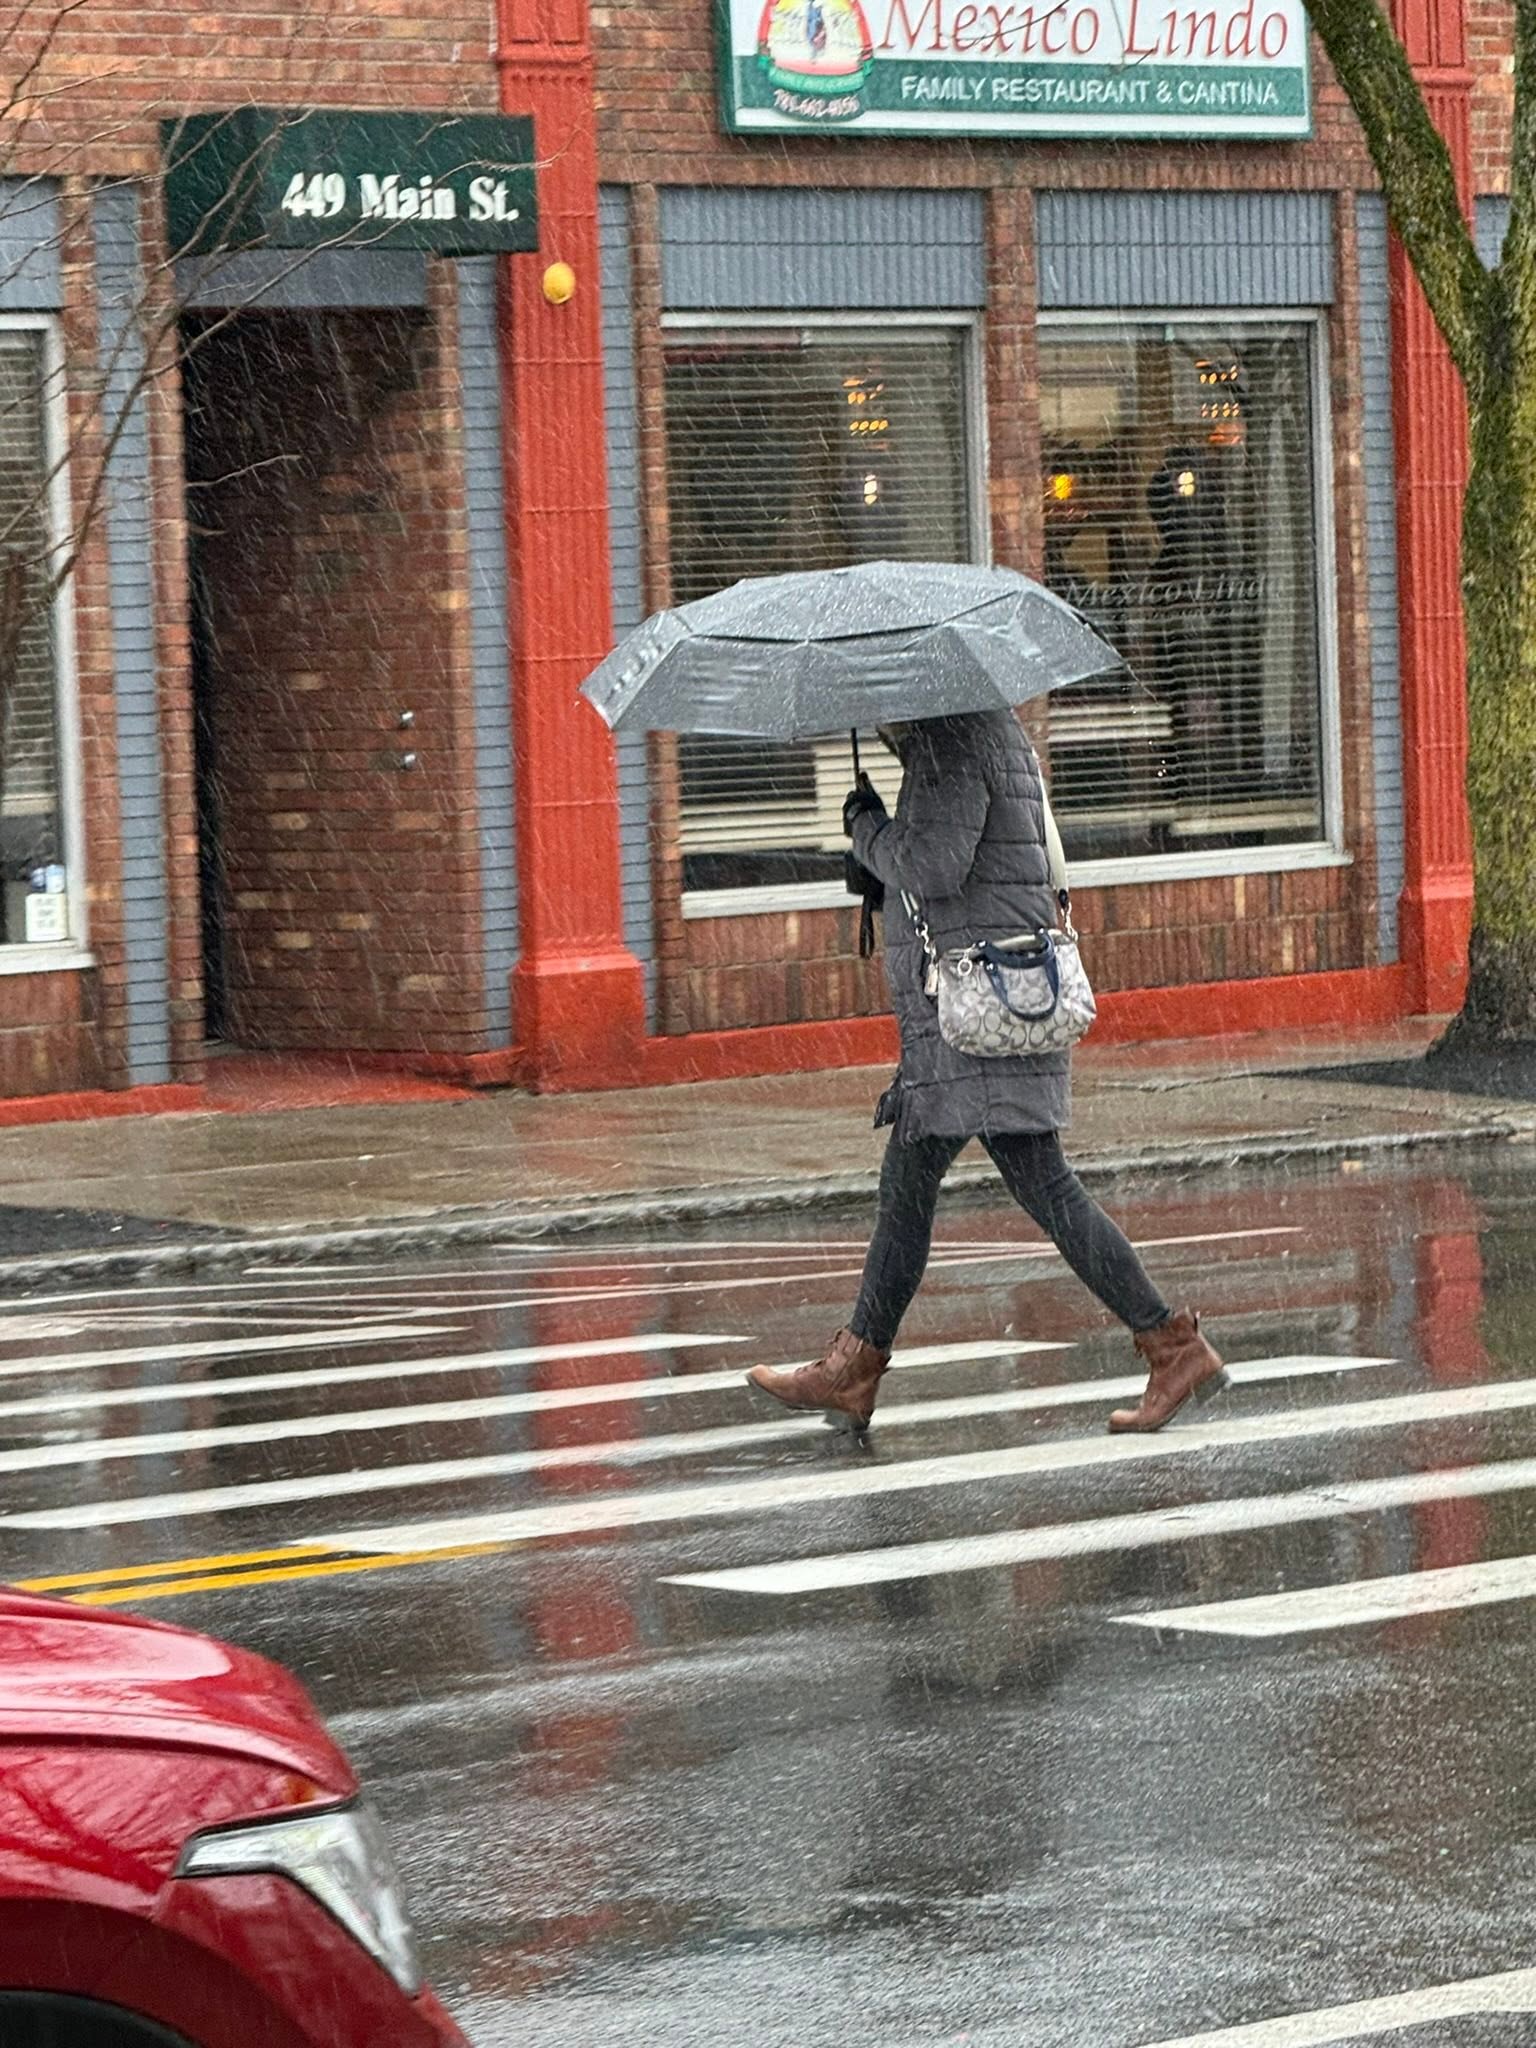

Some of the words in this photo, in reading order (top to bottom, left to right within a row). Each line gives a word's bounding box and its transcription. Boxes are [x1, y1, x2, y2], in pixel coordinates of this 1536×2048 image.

[876, 0, 1100, 54] Mexico
[1124, 0, 1289, 58] Lindo
[901, 76, 986, 101] FAMILY
[991, 78, 1150, 104] RESTAURANT
[1155, 80, 1174, 104] &
[1177, 80, 1280, 105] CANTINA
[281, 171, 346, 218] 449
[356, 173, 458, 220] Main
[469, 175, 520, 222] St.
